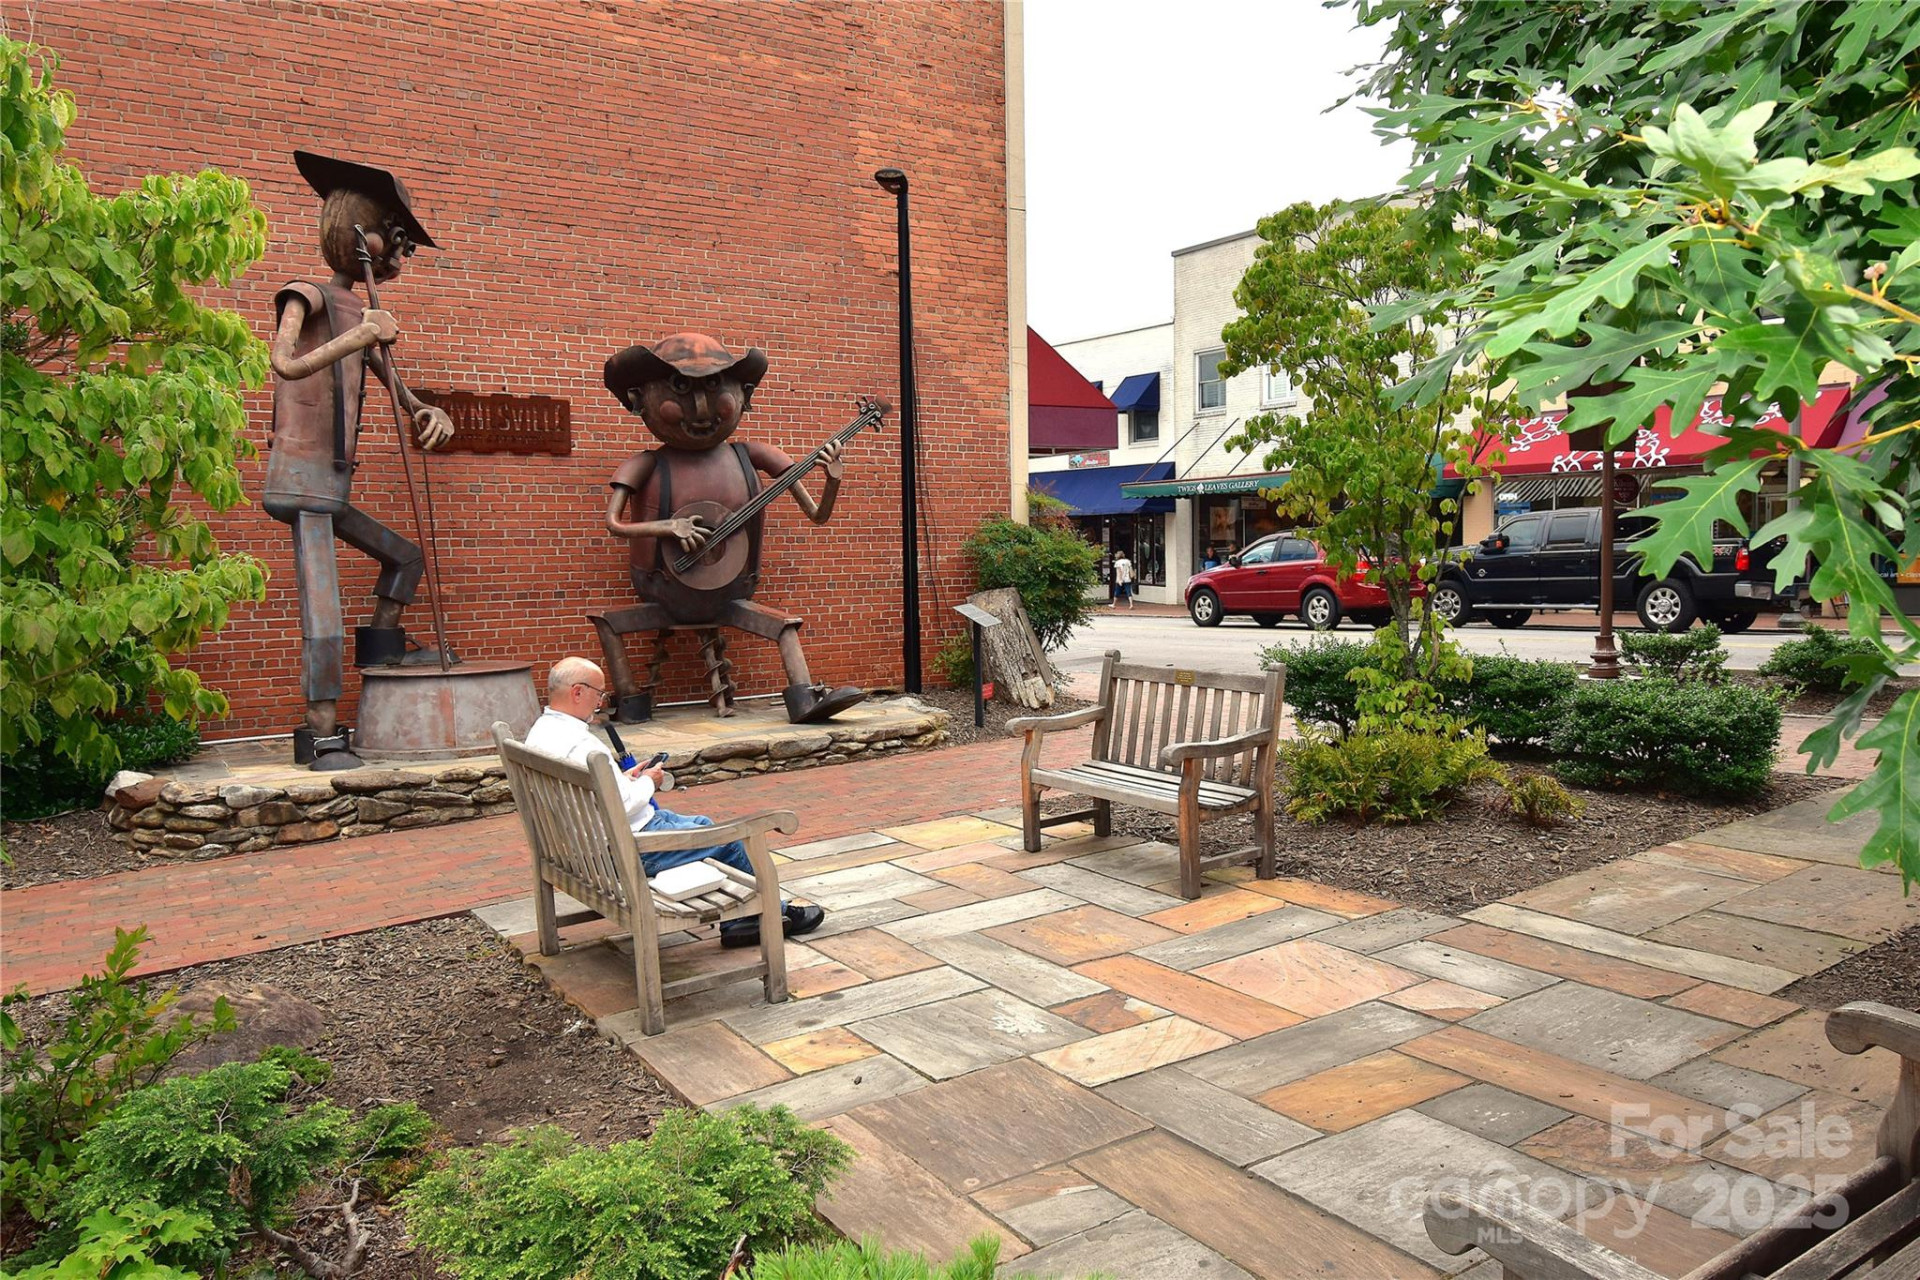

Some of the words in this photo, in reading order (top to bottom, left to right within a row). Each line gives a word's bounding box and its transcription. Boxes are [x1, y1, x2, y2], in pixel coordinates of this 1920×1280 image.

[1205, 482, 1228, 490] LEAVES
[1229, 480, 1259, 489] GALLERY
[1499, 492, 1518, 500] OPEN
